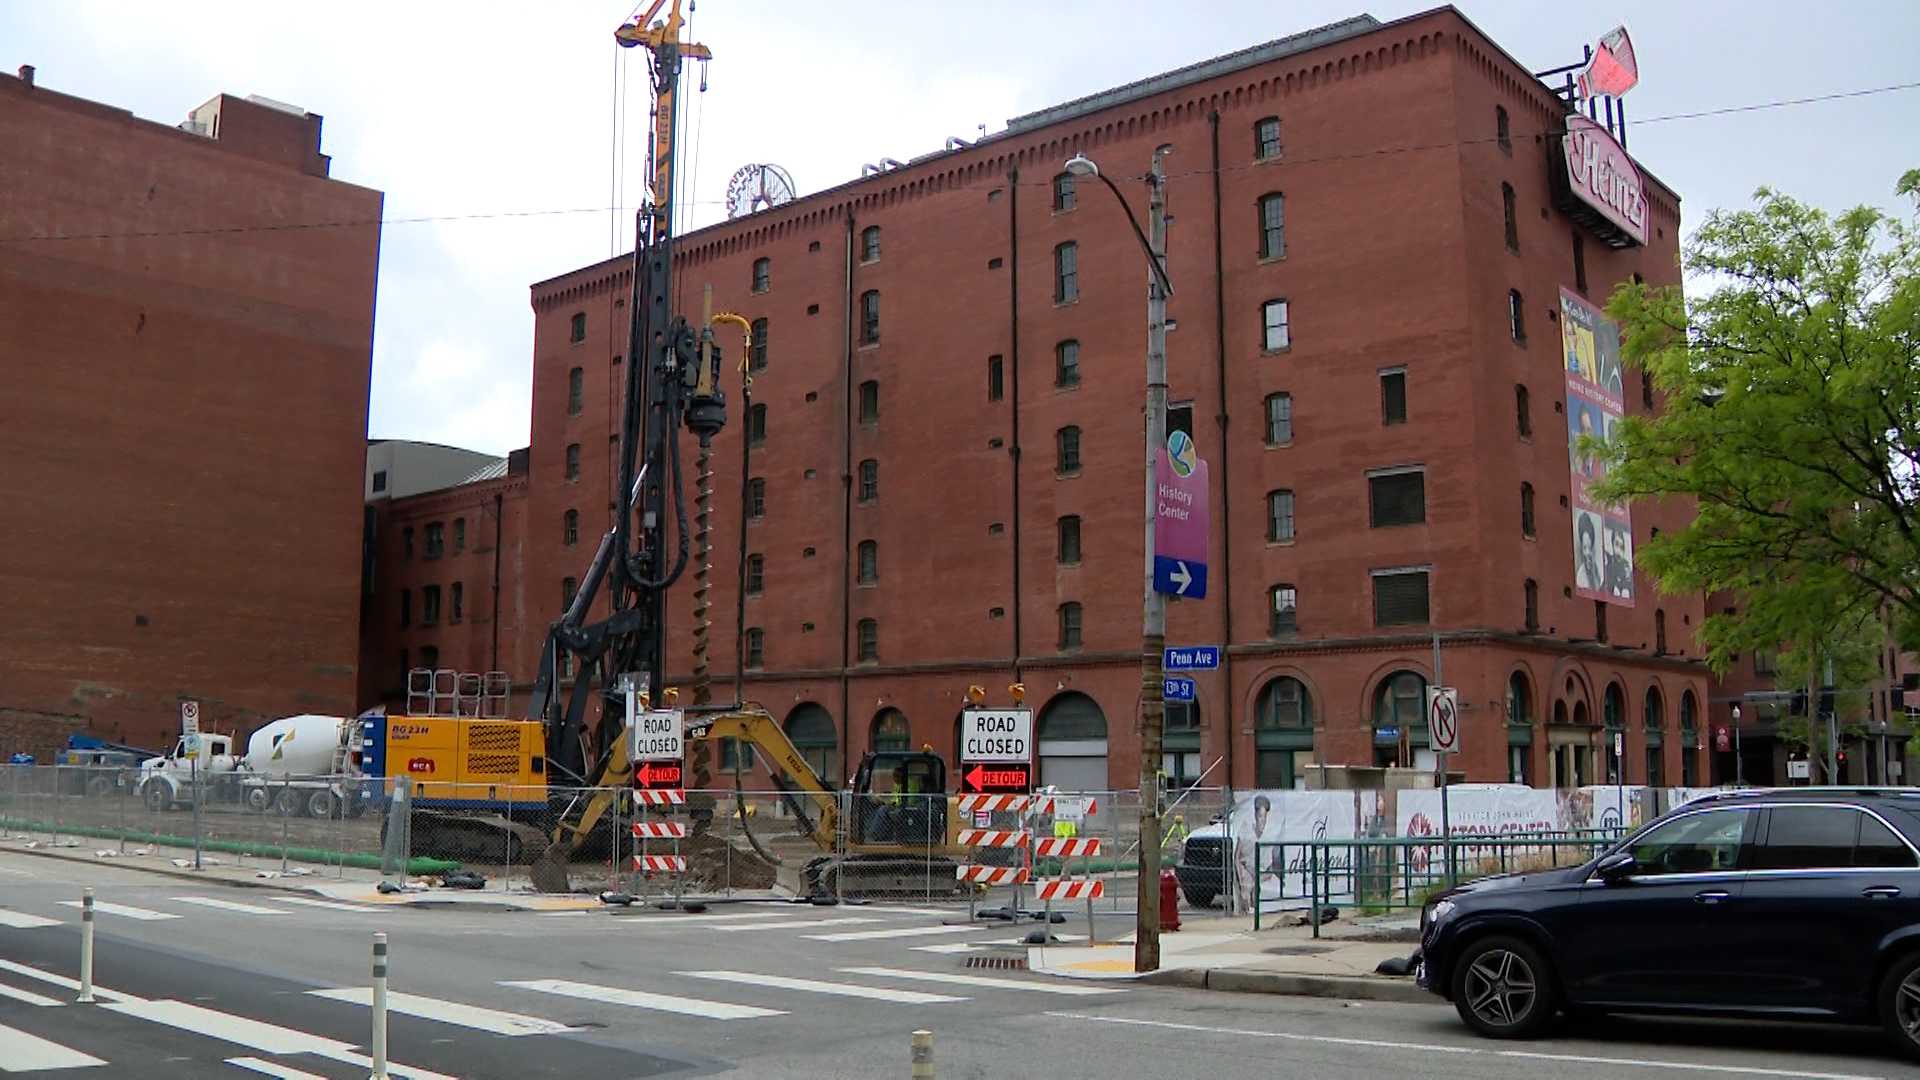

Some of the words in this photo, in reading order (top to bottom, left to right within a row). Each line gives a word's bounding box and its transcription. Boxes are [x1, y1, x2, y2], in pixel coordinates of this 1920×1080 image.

[1569, 131, 1641, 228] Heinz
[1159, 482, 1192, 506] History
[1158, 503, 1189, 520] Center
[1170, 651, 1192, 665] Penn
[1195, 651, 1212, 664] Ave
[1166, 681, 1179, 695] 13th
[1181, 682, 1189, 696] St
[644, 719, 671, 733] ROAD
[691, 727, 706, 737] CAT
[976, 717, 1016, 732] ROAD
[638, 737, 678, 753] CLOSED
[968, 739, 1024, 754] CLOSED
[648, 768, 679, 780] DETOUR
[982, 773, 1025, 784] DETOUR
